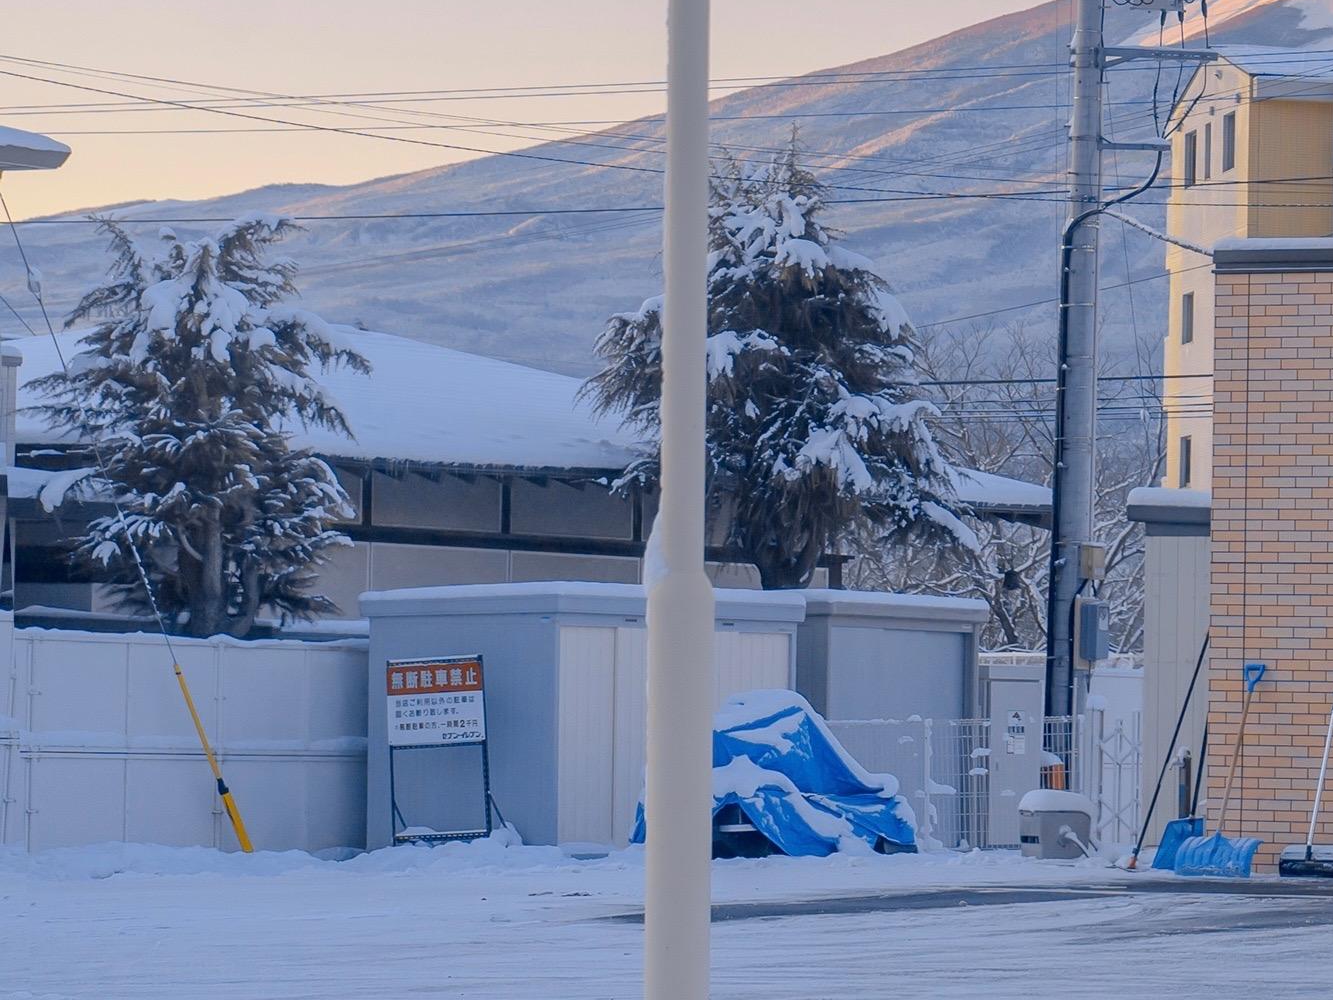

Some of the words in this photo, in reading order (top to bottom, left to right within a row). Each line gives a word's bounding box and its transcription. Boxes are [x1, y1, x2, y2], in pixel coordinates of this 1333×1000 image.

[391, 667, 478, 690] 無断駐車禁止
